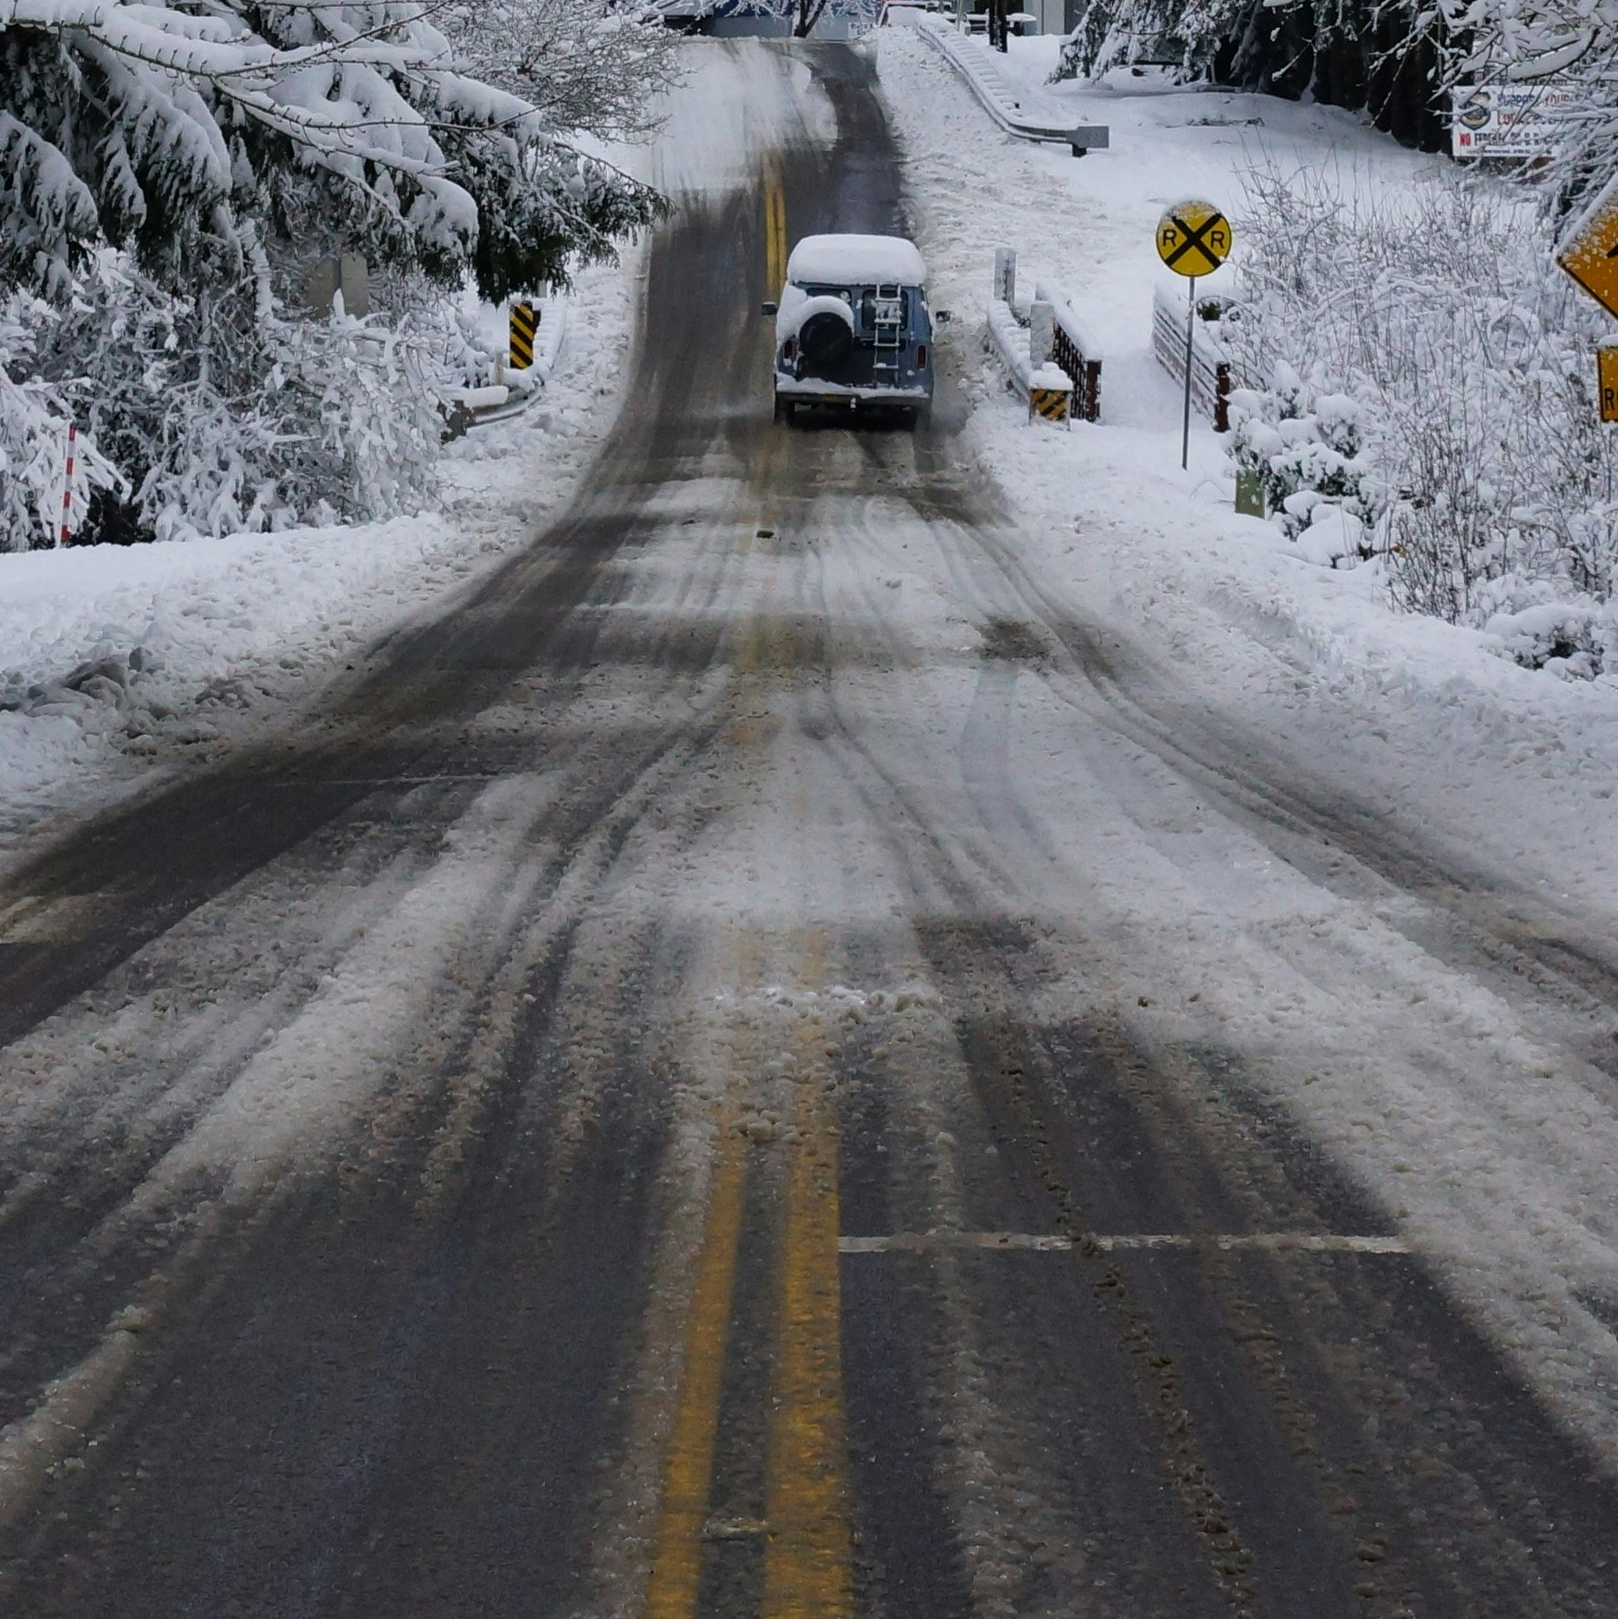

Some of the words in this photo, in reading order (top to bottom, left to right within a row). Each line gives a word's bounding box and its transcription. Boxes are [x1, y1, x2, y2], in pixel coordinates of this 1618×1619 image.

[1459, 133, 1471, 147] NO
[1162, 228, 1177, 247] R
[1210, 230, 1225, 249] R
